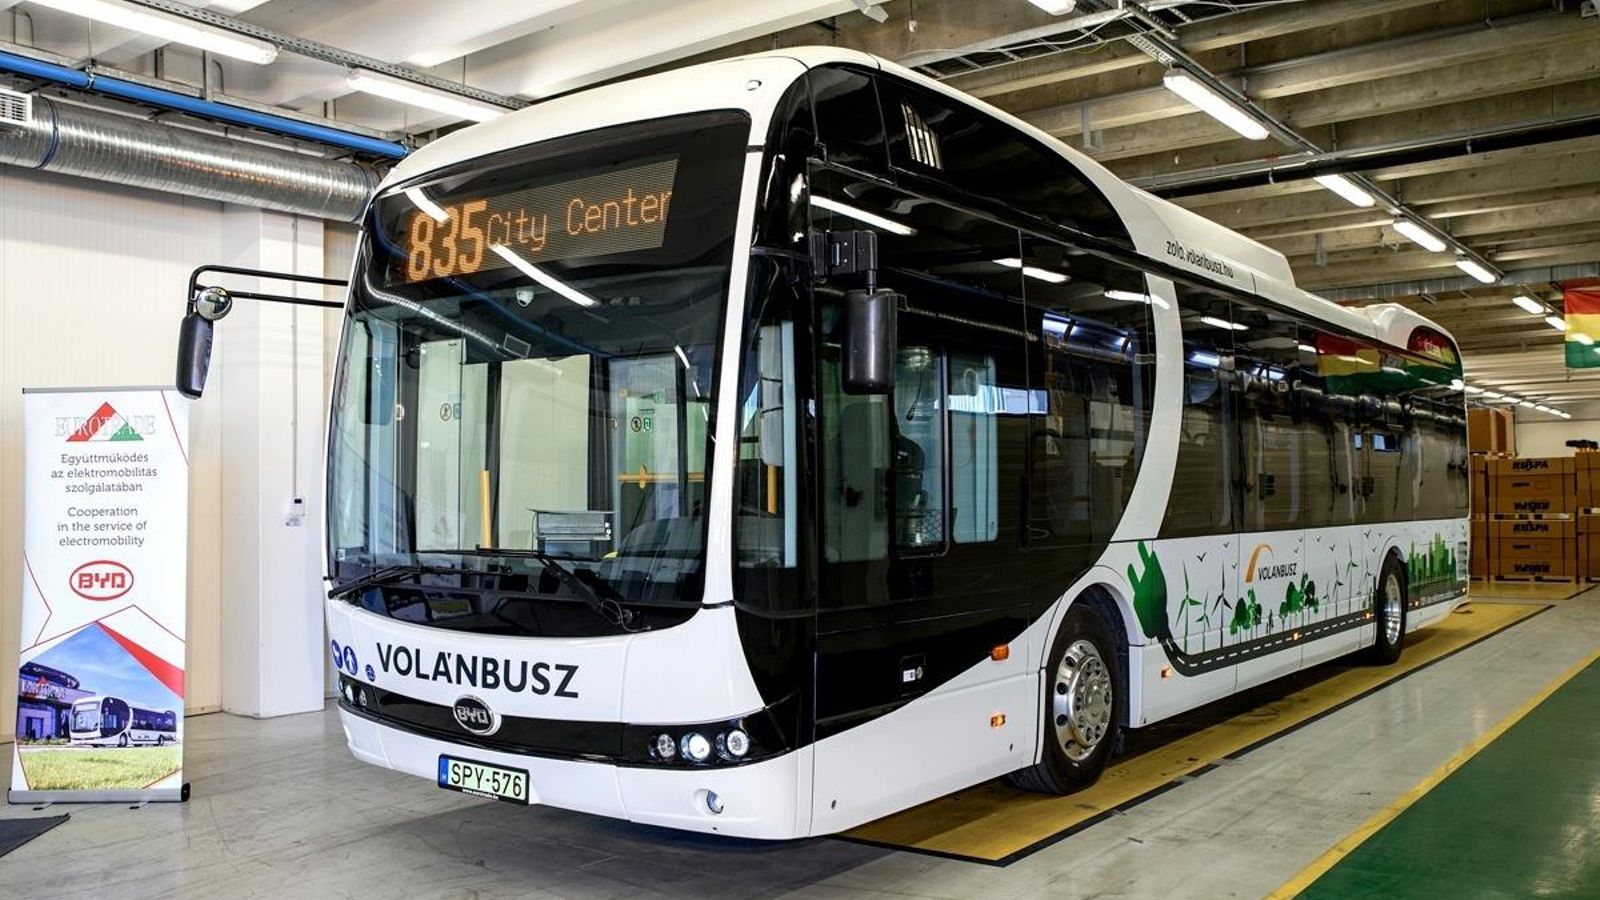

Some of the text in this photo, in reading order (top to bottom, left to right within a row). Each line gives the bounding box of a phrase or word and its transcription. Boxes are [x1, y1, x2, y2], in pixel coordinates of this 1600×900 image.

[406, 188, 672, 282] 835 City Center
[54, 414, 157, 438] EUROTRADE
[50, 467, 158, 479] az elektromobilitás
[65, 481, 143, 495] szolgálatában
[67, 506, 138, 519] Cooperation
[57, 520, 147, 532] in the service of
[59, 535, 145, 548] electromobility
[78, 572, 126, 589] BYD
[376, 641, 580, 699] VOLÁNBUSZ
[457, 704, 489, 725] BYD
[451, 762, 522, 798] SPY-576
